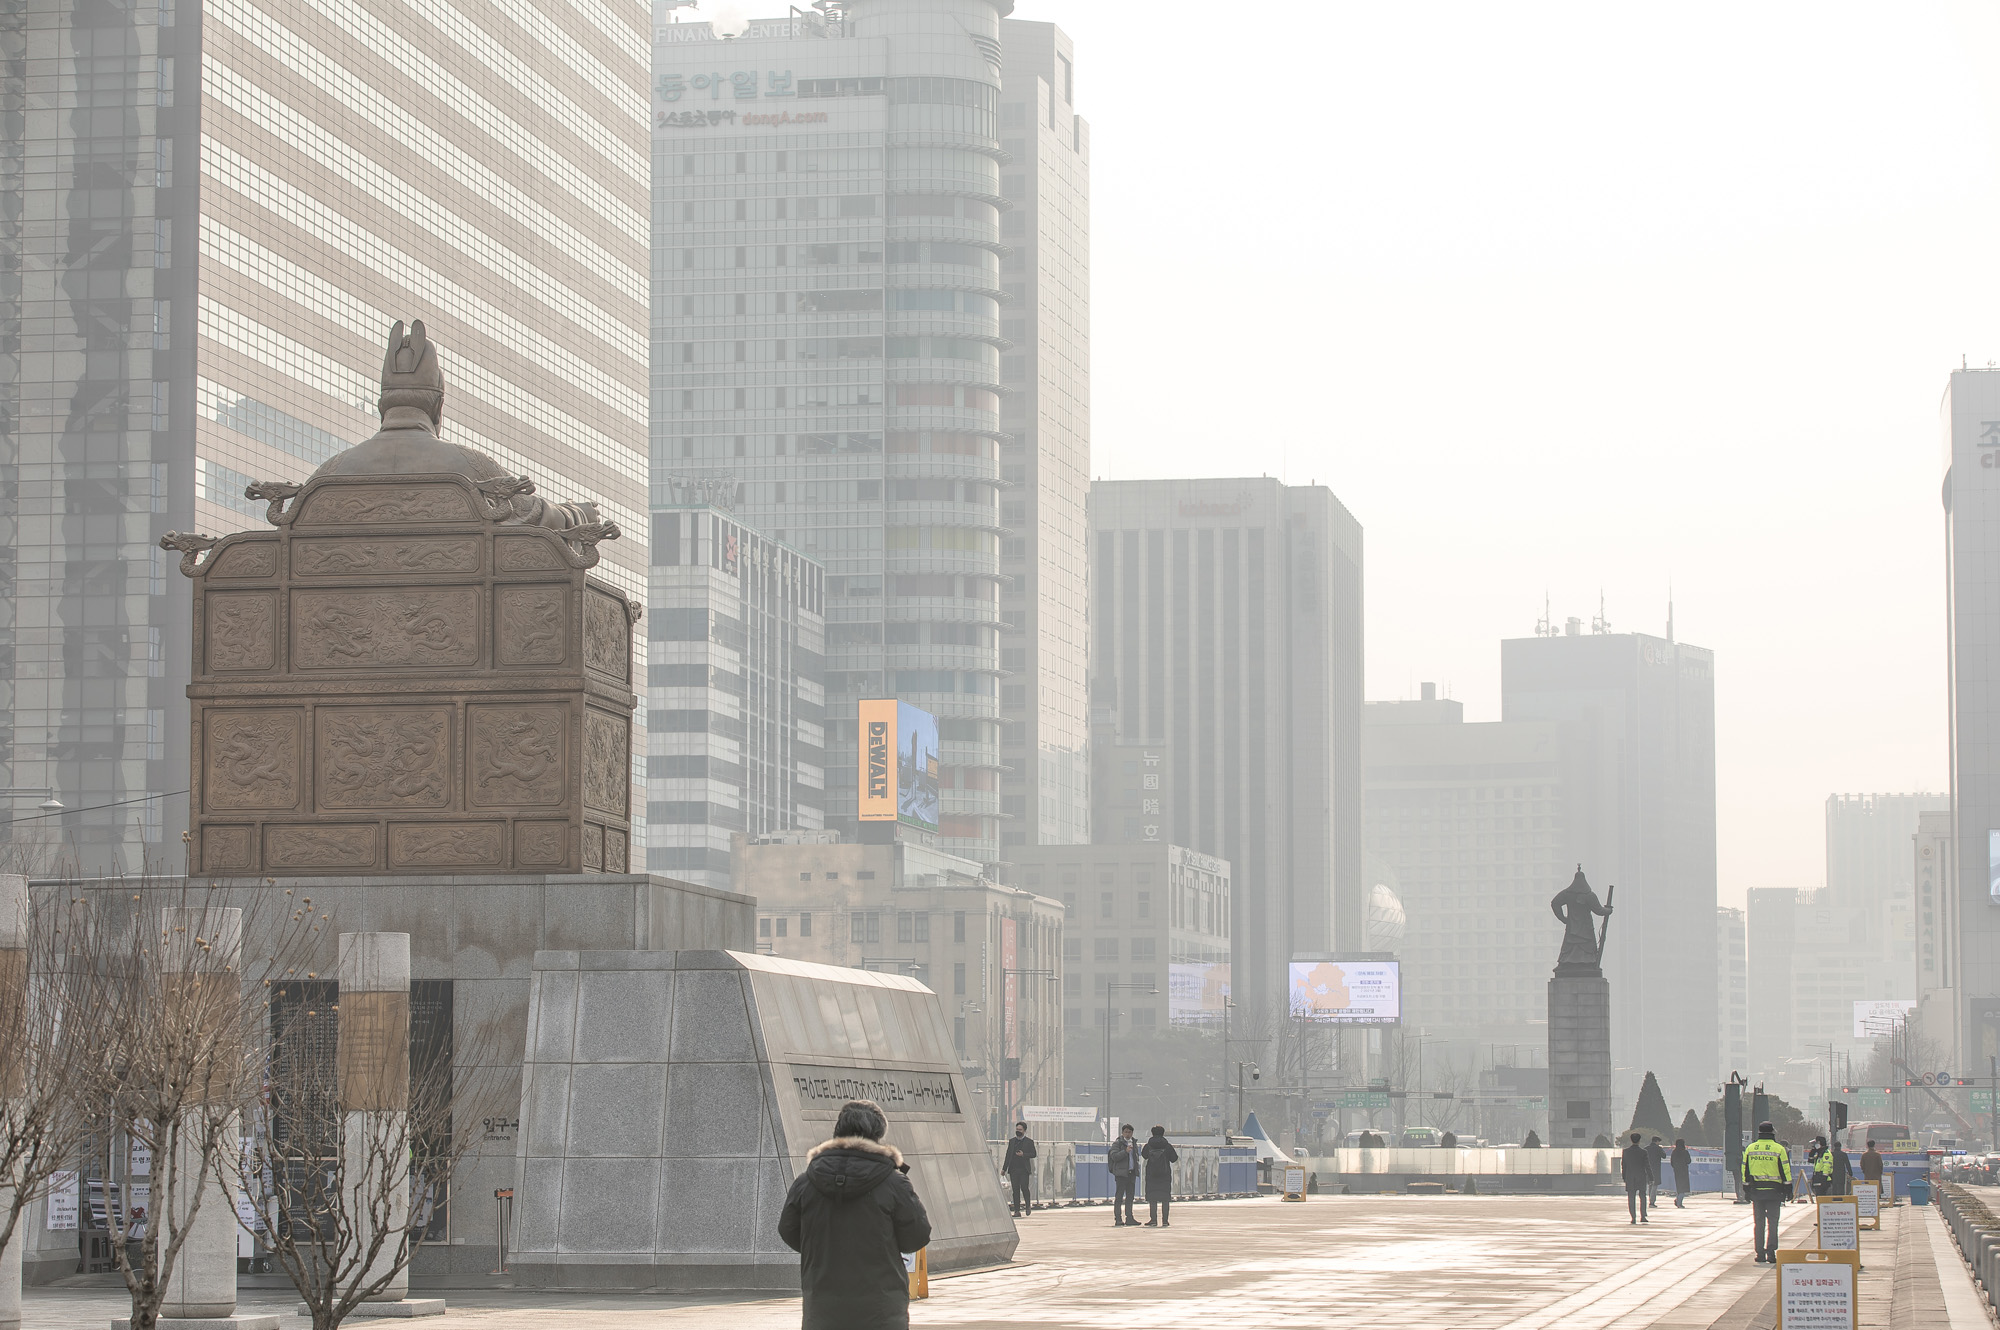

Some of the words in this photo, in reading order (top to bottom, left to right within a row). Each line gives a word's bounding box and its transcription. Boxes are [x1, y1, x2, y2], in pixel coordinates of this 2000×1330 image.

[655, 70, 795, 102] 동아일보
[658, 109, 736, 128] 스포츠동아
[742, 111, 828, 127] dongA.com
[869, 721, 886, 799] DEWALT
[483, 1117, 509, 1132] 입구
